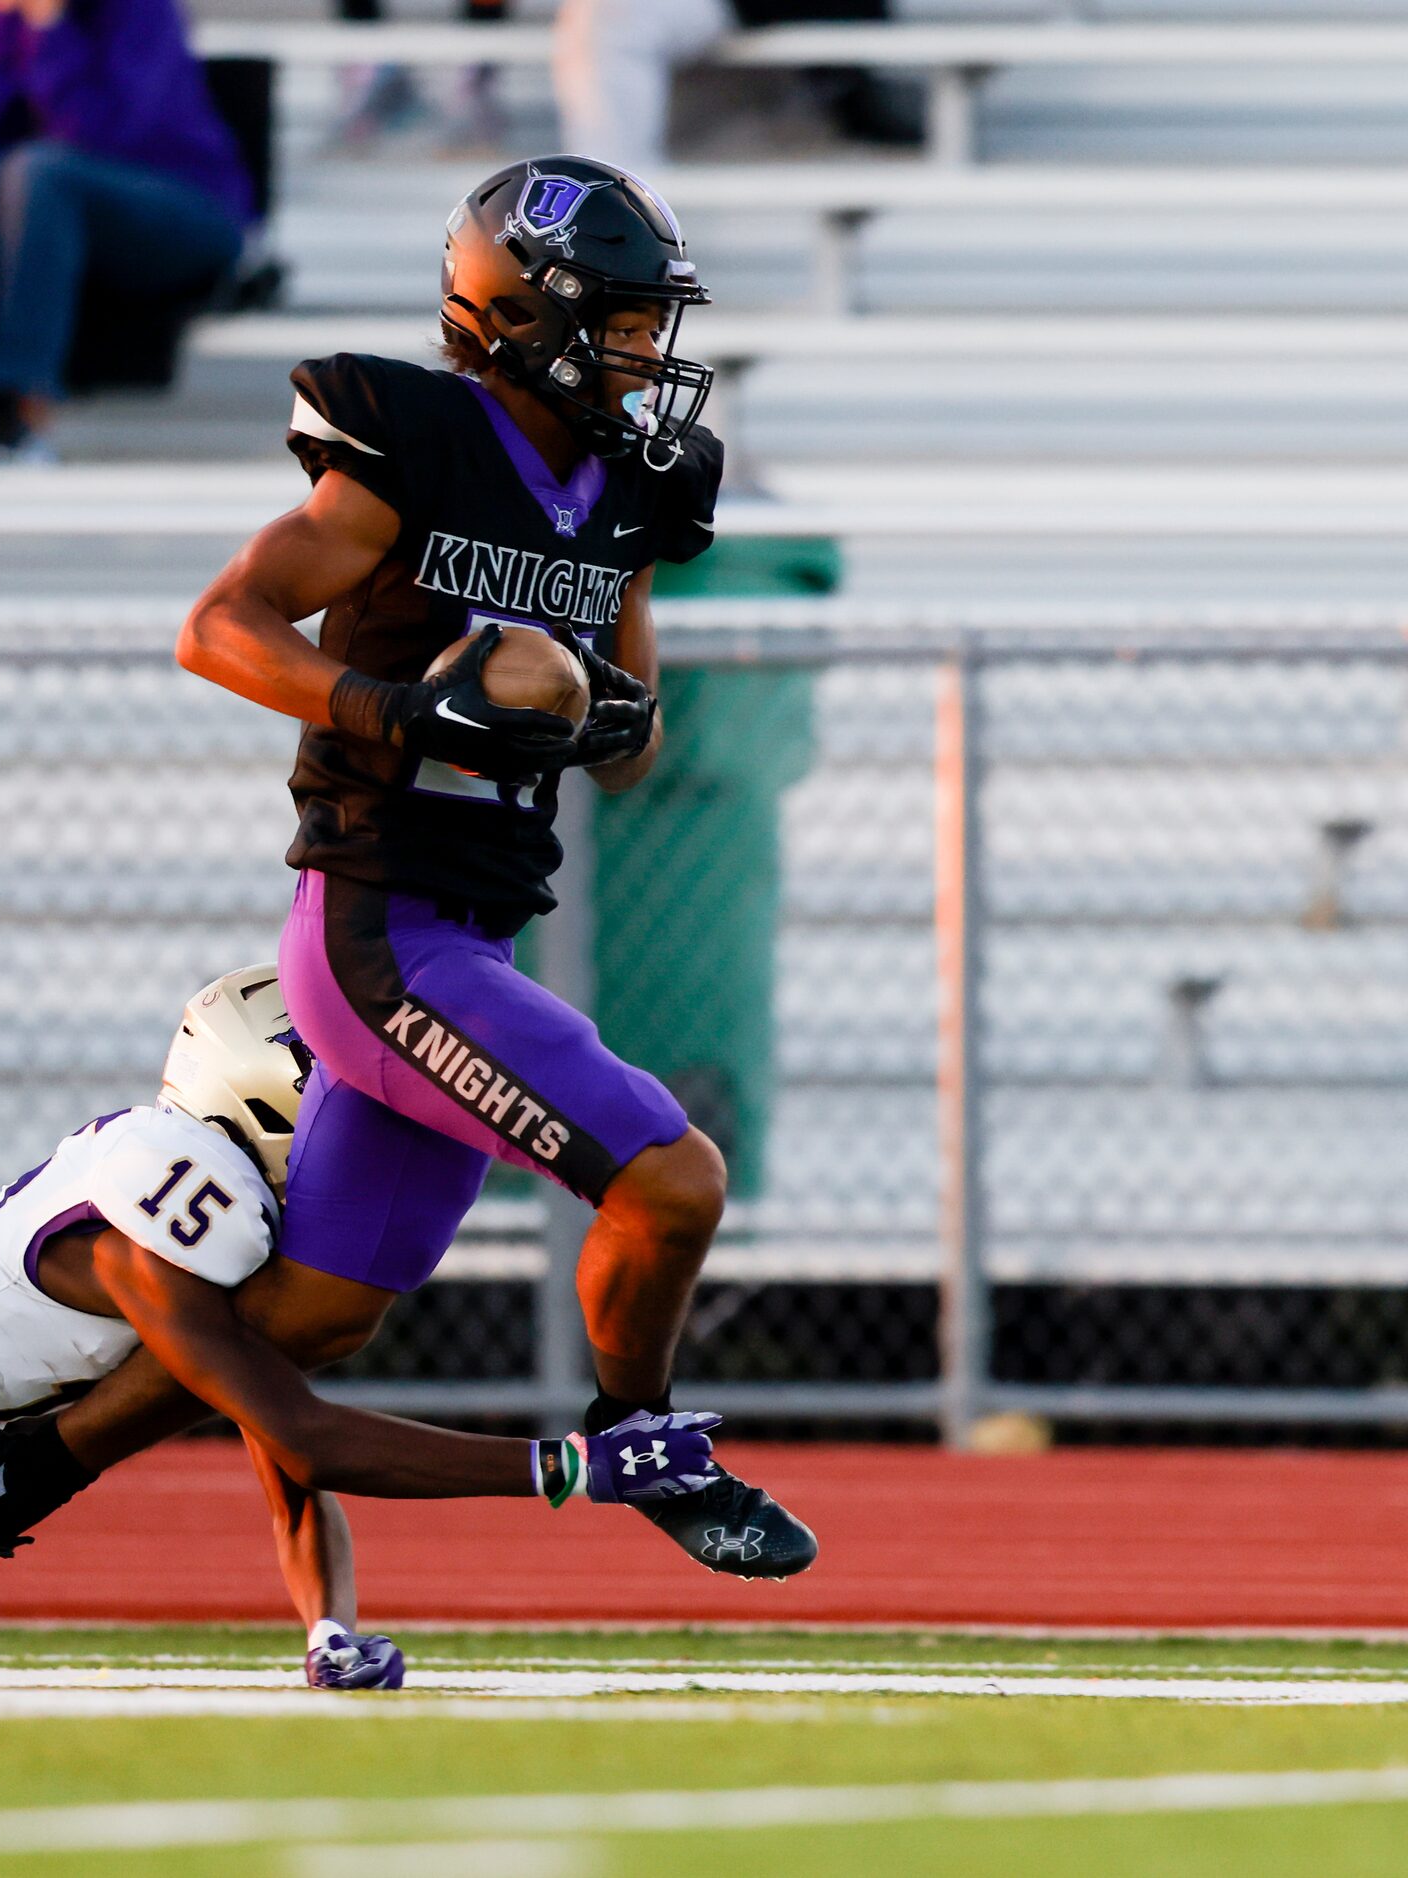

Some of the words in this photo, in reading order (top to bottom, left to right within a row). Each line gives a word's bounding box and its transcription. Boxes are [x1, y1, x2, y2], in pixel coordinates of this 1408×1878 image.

[530, 181, 570, 220] I
[414, 531, 634, 625] KNIGHTS
[383, 1000, 571, 1161] KNIGHTS
[133, 1155, 239, 1250] 15
